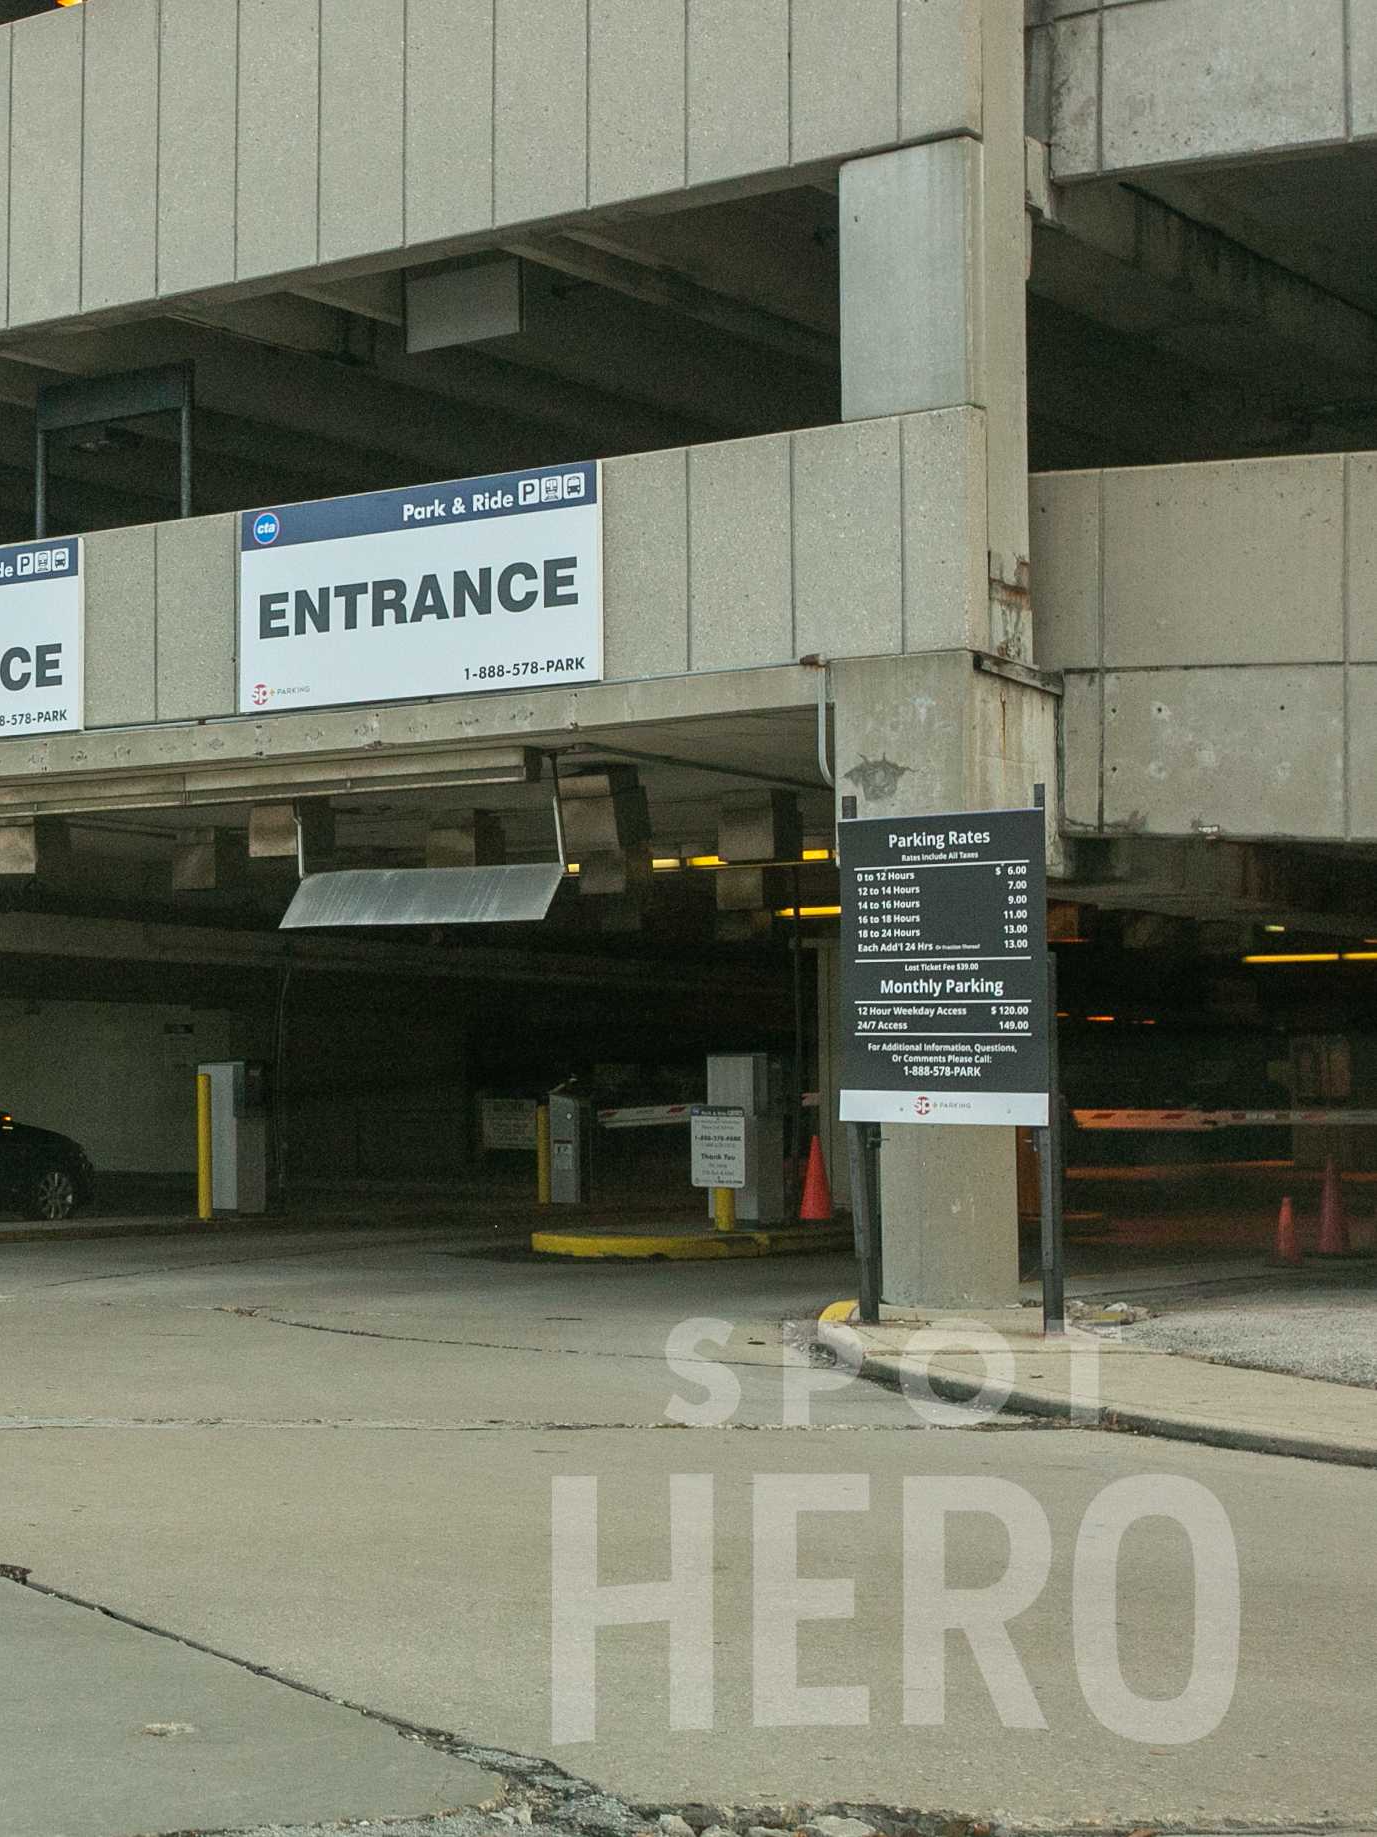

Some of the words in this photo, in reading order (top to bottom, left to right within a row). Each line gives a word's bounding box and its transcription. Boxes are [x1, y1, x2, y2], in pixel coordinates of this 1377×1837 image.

[403, 502, 445, 521] Park
[452, 499, 465, 515] &
[473, 492, 514, 511] Ride
[256, 521, 275, 534] cta
[259, 556, 579, 639] ENTRANCE
[464, 656, 585, 680] 1-888-578-PARK
[889, 832, 945, 848] Parking
[949, 831, 990, 844] Rates
[902, 854, 920, 862] Rates
[922, 853, 947, 861] Include
[949, 852, 958, 860] All
[959, 851, 978, 859] Taxes
[876, 873, 886, 881] 12
[889, 872, 915, 880] Hours
[995, 868, 1001, 876] $
[1008, 866, 1026, 875] 6.00
[858, 888, 868, 896] 12
[881, 887, 892, 895] 14
[894, 886, 920, 894] Hours
[1008, 881, 1027, 889] 7.00
[858, 902, 868, 910] 14
[870, 902, 879, 910] to
[881, 901, 892, 909] 16
[894, 900, 920, 909] Hours
[1008, 896, 1027, 904] 9.00
[870, 916, 879, 924] to
[881, 916, 892, 924] 18
[894, 915, 920, 923] Hours
[1003, 911, 1027, 919] 11.00
[881, 930, 892, 938] 24
[894, 929, 920, 937] Hours
[1004, 925, 1028, 934] 13.00
[858, 944, 878, 952] Each
[881, 943, 903, 952] Add'l
[905, 943, 916, 951] 24
[918, 942, 933, 950] Hrs
[1004, 940, 1028, 949] 13.00
[922, 963, 941, 971] Ticket
[881, 979, 942, 996] Monthly
[946, 978, 1003, 996] Parking
[858, 1007, 868, 1015] 12
[870, 1007, 891, 1015] Hour
[893, 1007, 934, 1017] Weekday
[937, 1007, 966, 1015] Access
[991, 1007, 996, 1015] $
[999, 1006, 1028, 1015] 120.00
[857, 1021, 875, 1030] 24/7
[878, 1022, 908, 1030] Access
[999, 1021, 1028, 1030] 149.00
[868, 1043, 880, 1051] For
[882, 1043, 922, 1051] Additional
[924, 1043, 973, 1052] Information,
[974, 1044, 1017, 1053] Questions,
[903, 1055, 946, 1063] Comments
[948, 1055, 972, 1063] Please
[974, 1055, 992, 1063] Call:
[903, 1066, 981, 1076] 1-888-578-PARK
